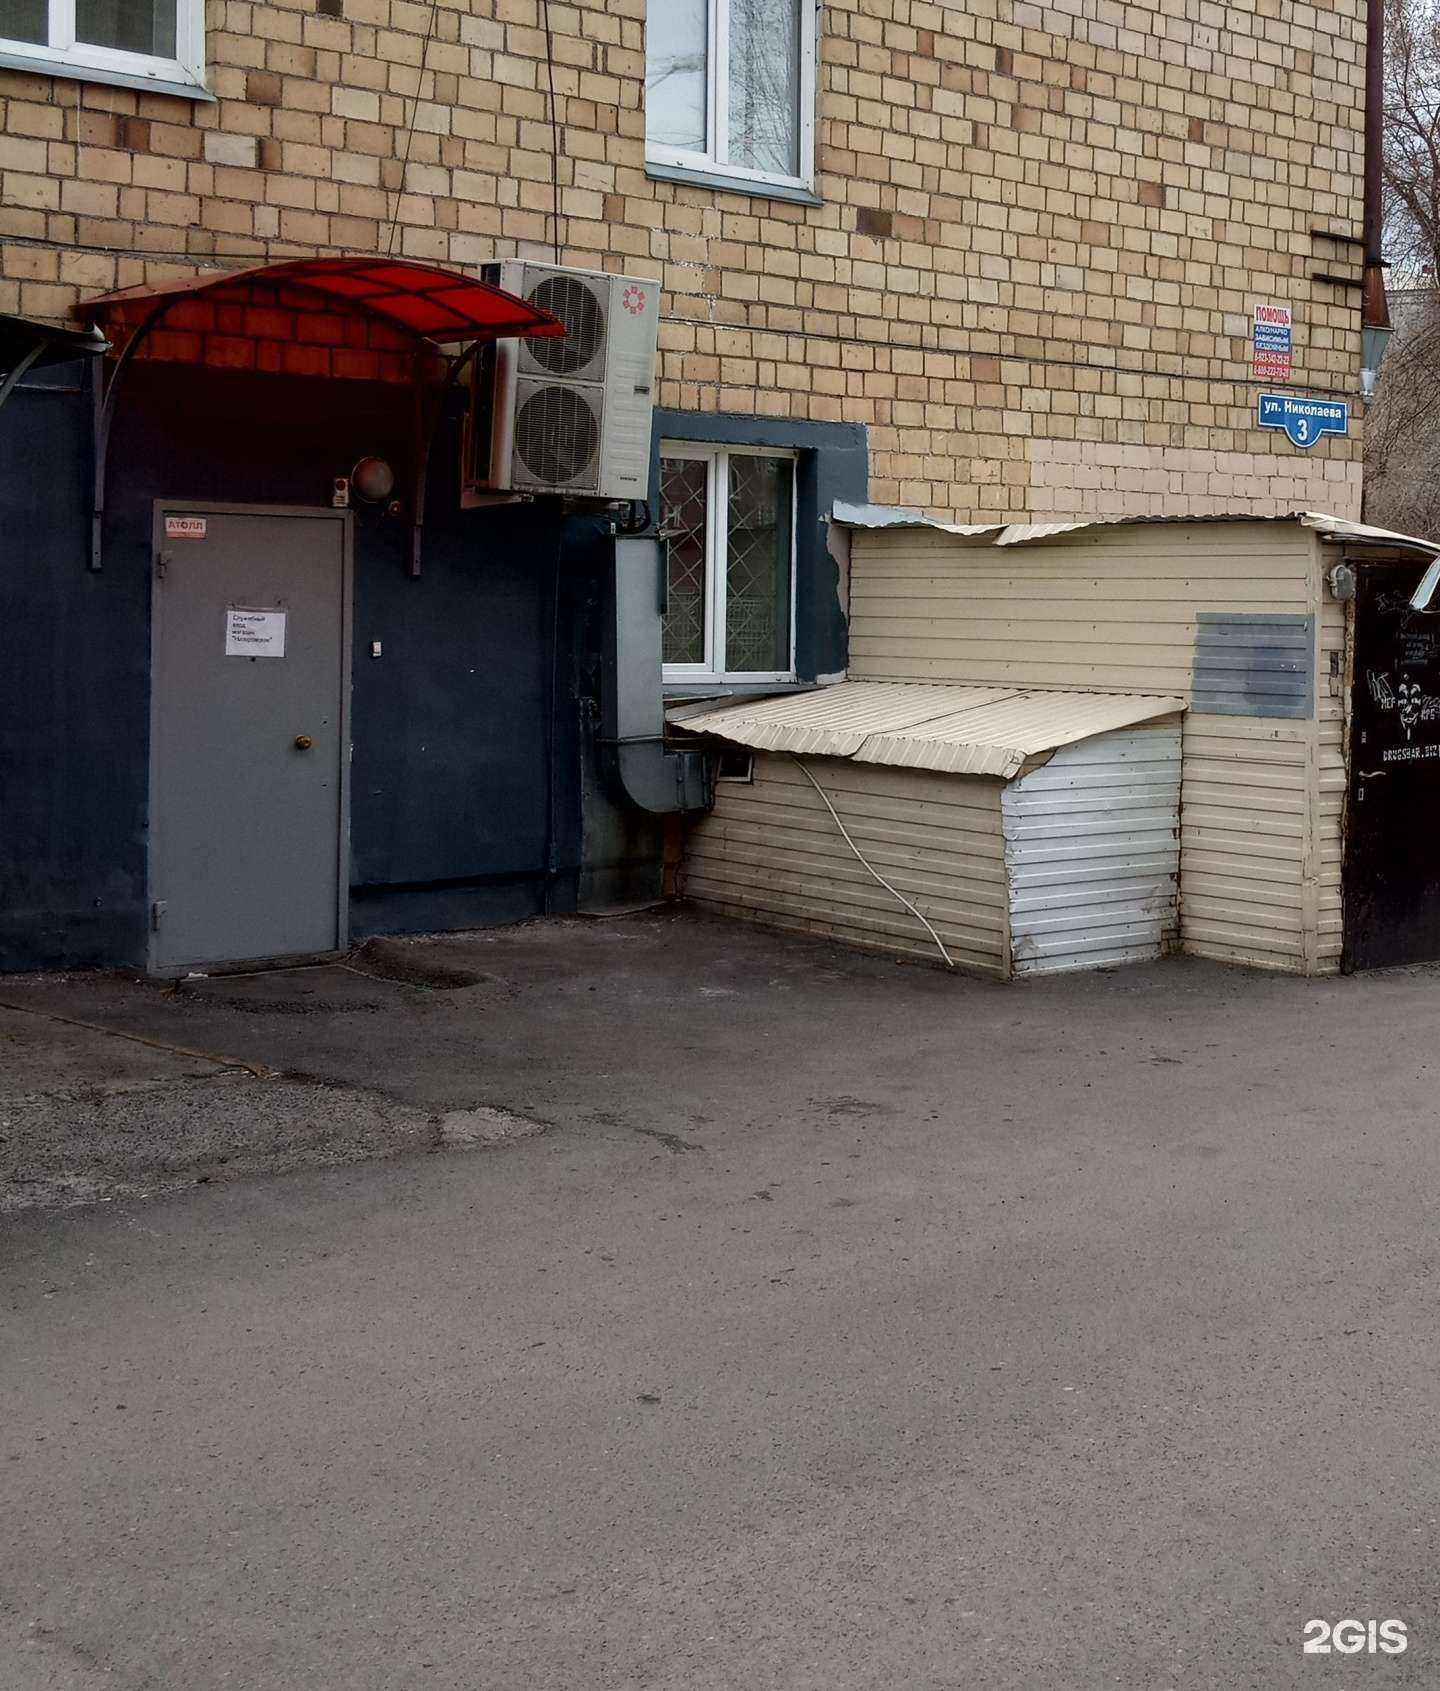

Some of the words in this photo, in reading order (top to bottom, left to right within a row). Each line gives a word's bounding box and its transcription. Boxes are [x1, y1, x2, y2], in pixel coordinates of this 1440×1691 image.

[1256, 306, 1289, 326] ПОМОЩЬ
[1265, 401, 1281, 413] ул.
[1284, 401, 1341, 418] Николаева
[1297, 419, 1308, 441] 3
[168, 521, 203, 530] АТОЛЛ
